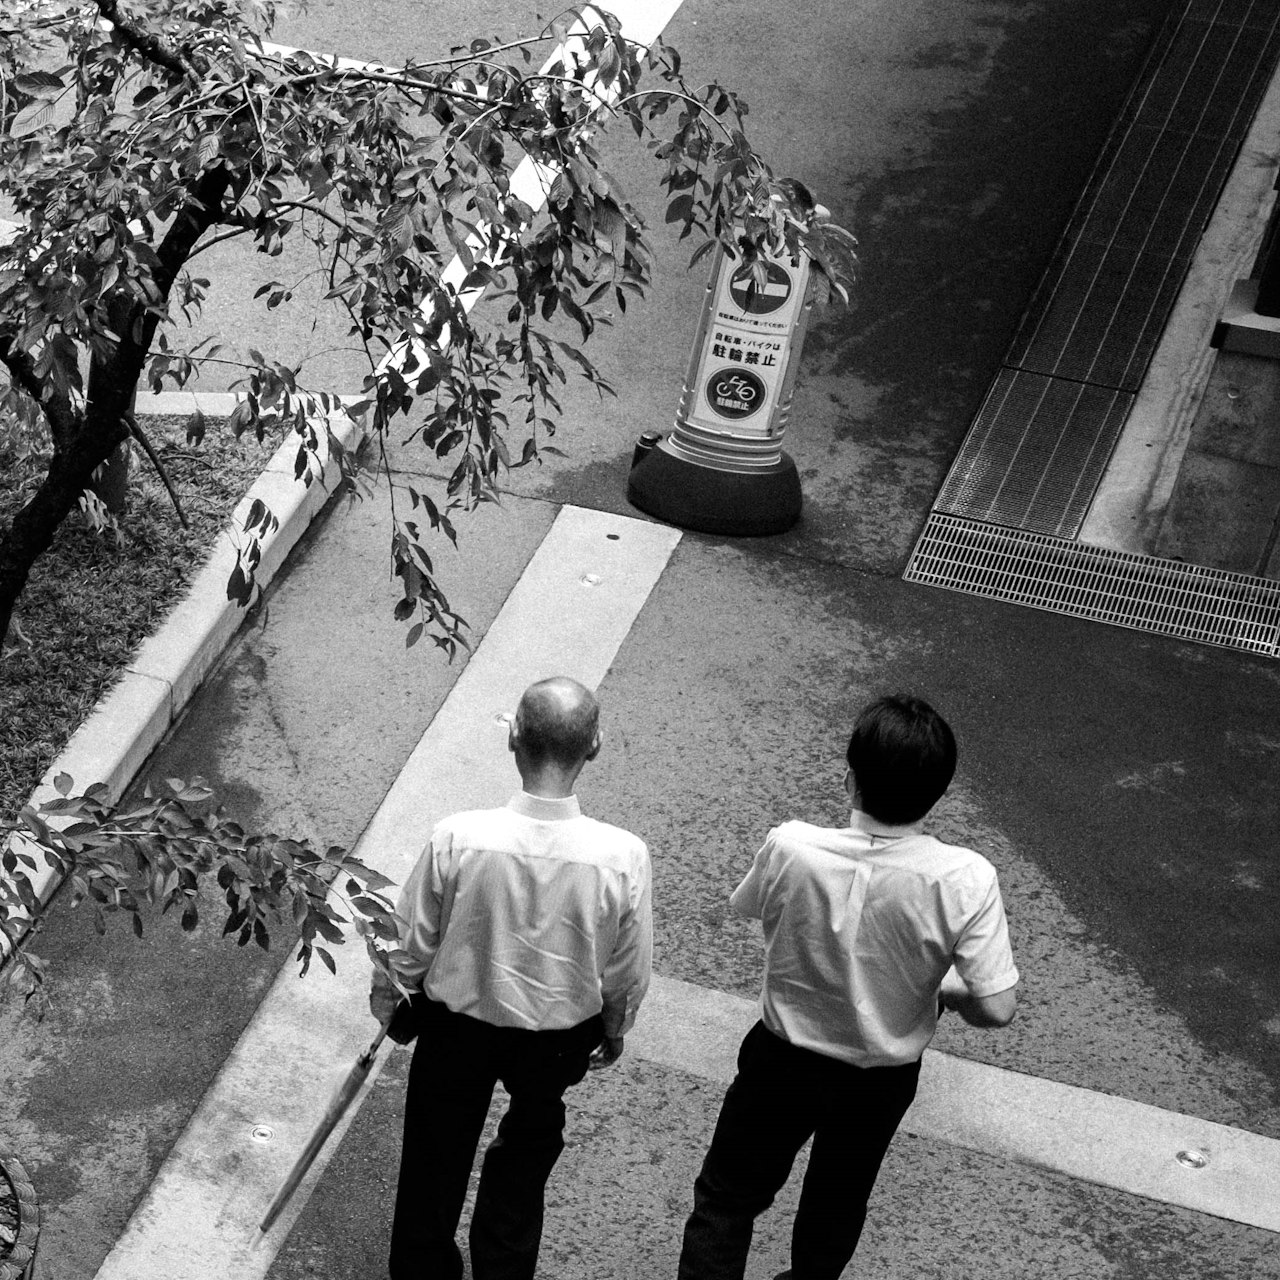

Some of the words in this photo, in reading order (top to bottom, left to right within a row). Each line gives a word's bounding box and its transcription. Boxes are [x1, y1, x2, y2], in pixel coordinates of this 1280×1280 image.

[715, 332, 781, 351] 自転車・バイクは
[712, 343, 776, 367] 駐輪禁止
[716, 396, 750, 411] 駐輪禁止
